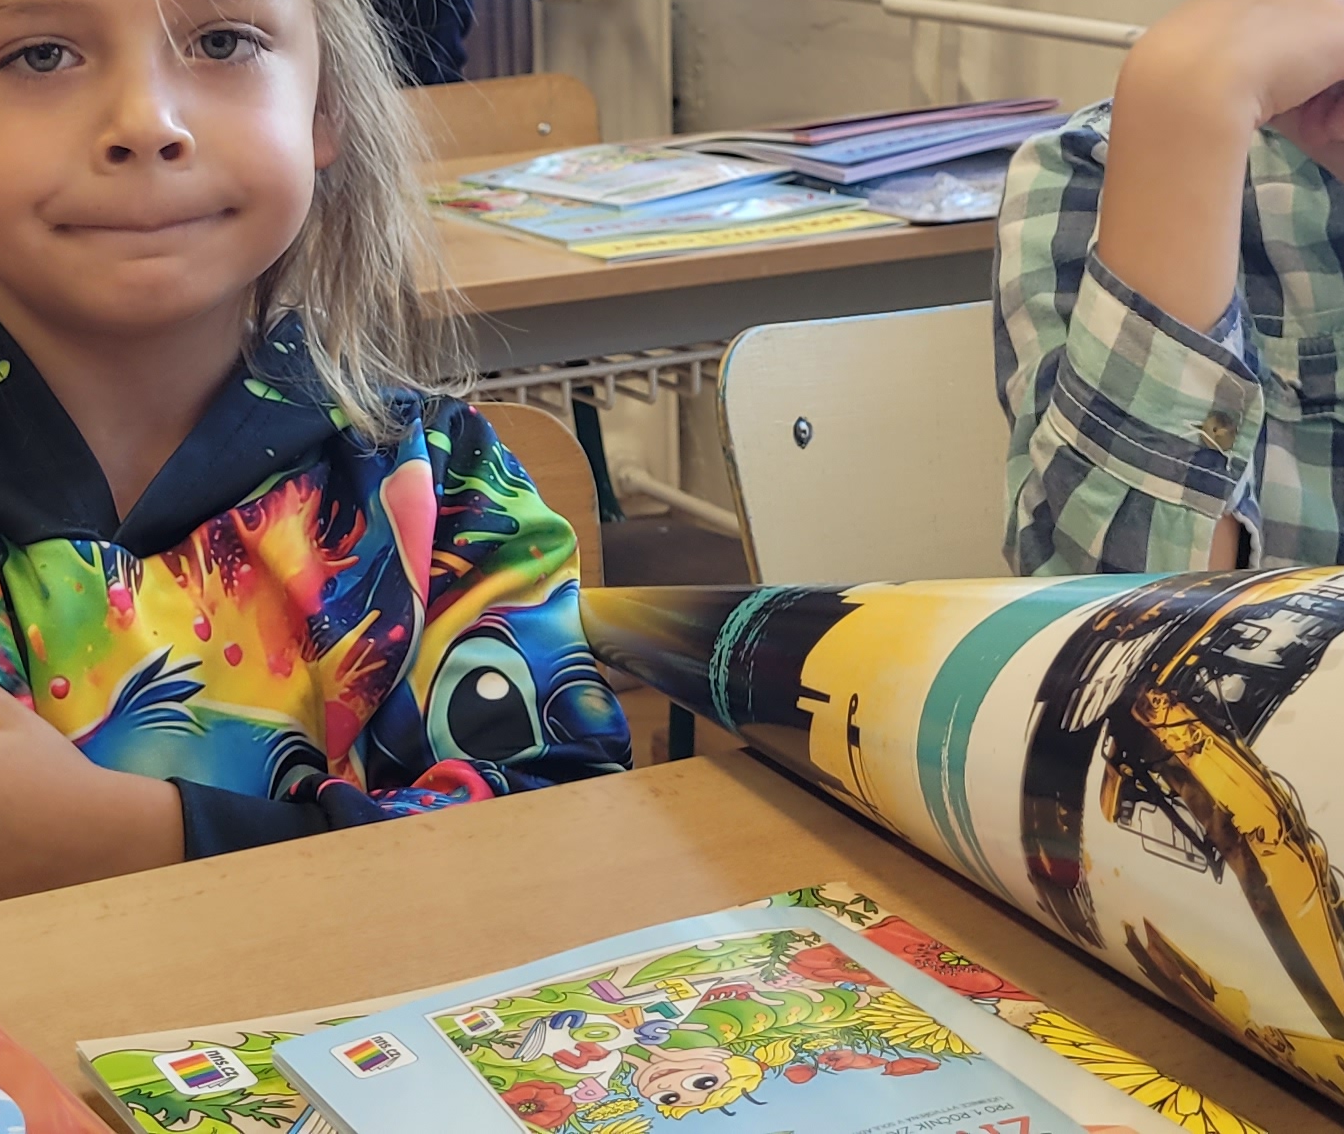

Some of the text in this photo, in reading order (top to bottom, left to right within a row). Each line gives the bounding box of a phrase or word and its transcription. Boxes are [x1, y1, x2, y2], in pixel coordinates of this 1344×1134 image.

[204, 1049, 240, 1078] nns.cz
[984, 1102, 1014, 1114] PRO
[914, 1111, 971, 1131] ROČNÍK
